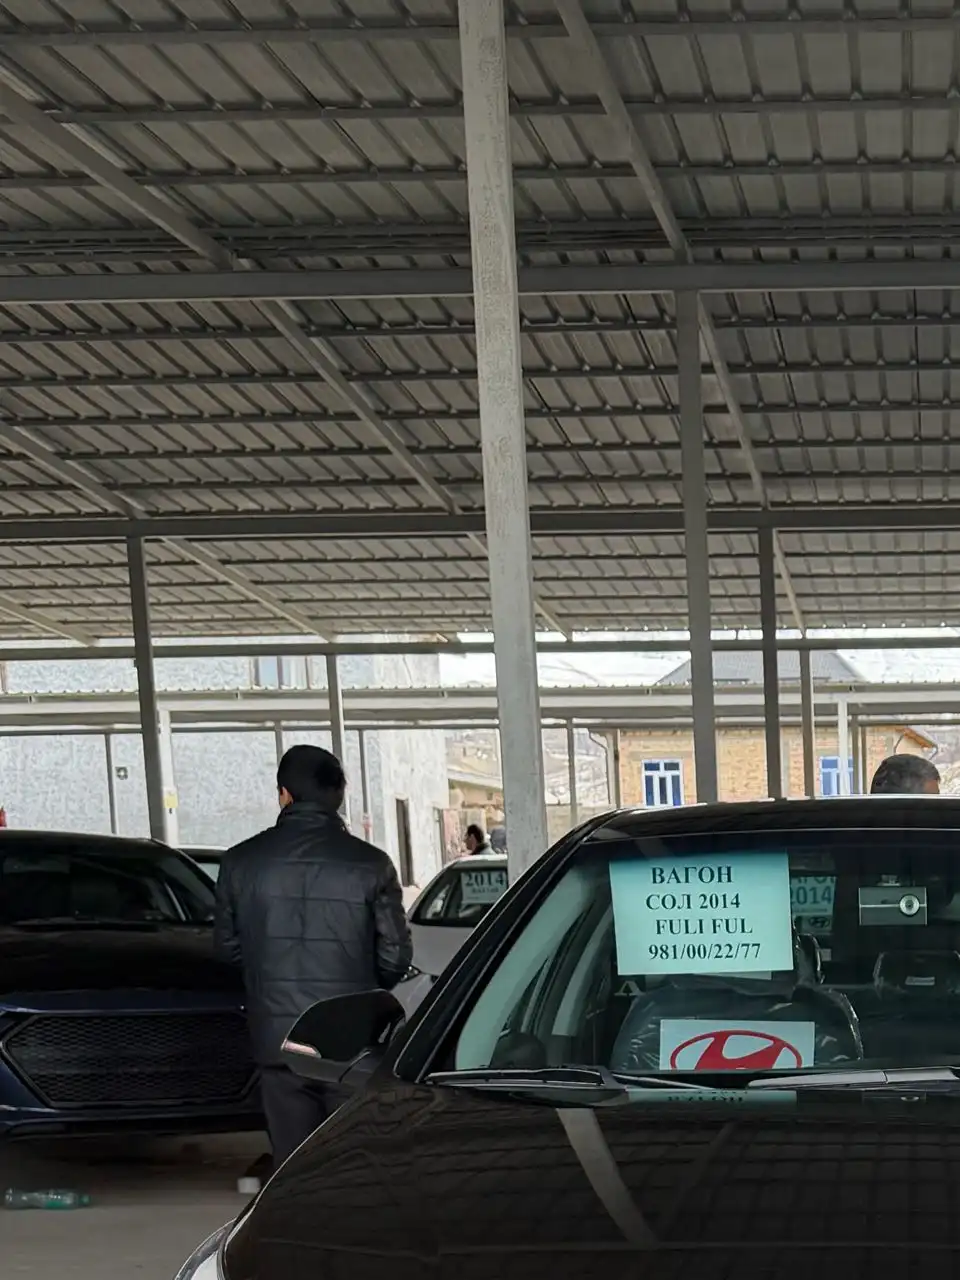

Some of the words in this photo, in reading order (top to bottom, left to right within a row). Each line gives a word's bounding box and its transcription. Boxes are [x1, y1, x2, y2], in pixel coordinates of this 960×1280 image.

[465, 872, 504, 887] 2014
[651, 866, 733, 885] ВАГОН
[645, 893, 692, 911] СОЛ
[699, 893, 741, 909] 2014
[655, 918, 704, 935] FULI
[711, 917, 753, 934] FUL
[648, 942, 761, 960] 981/00/22/77
